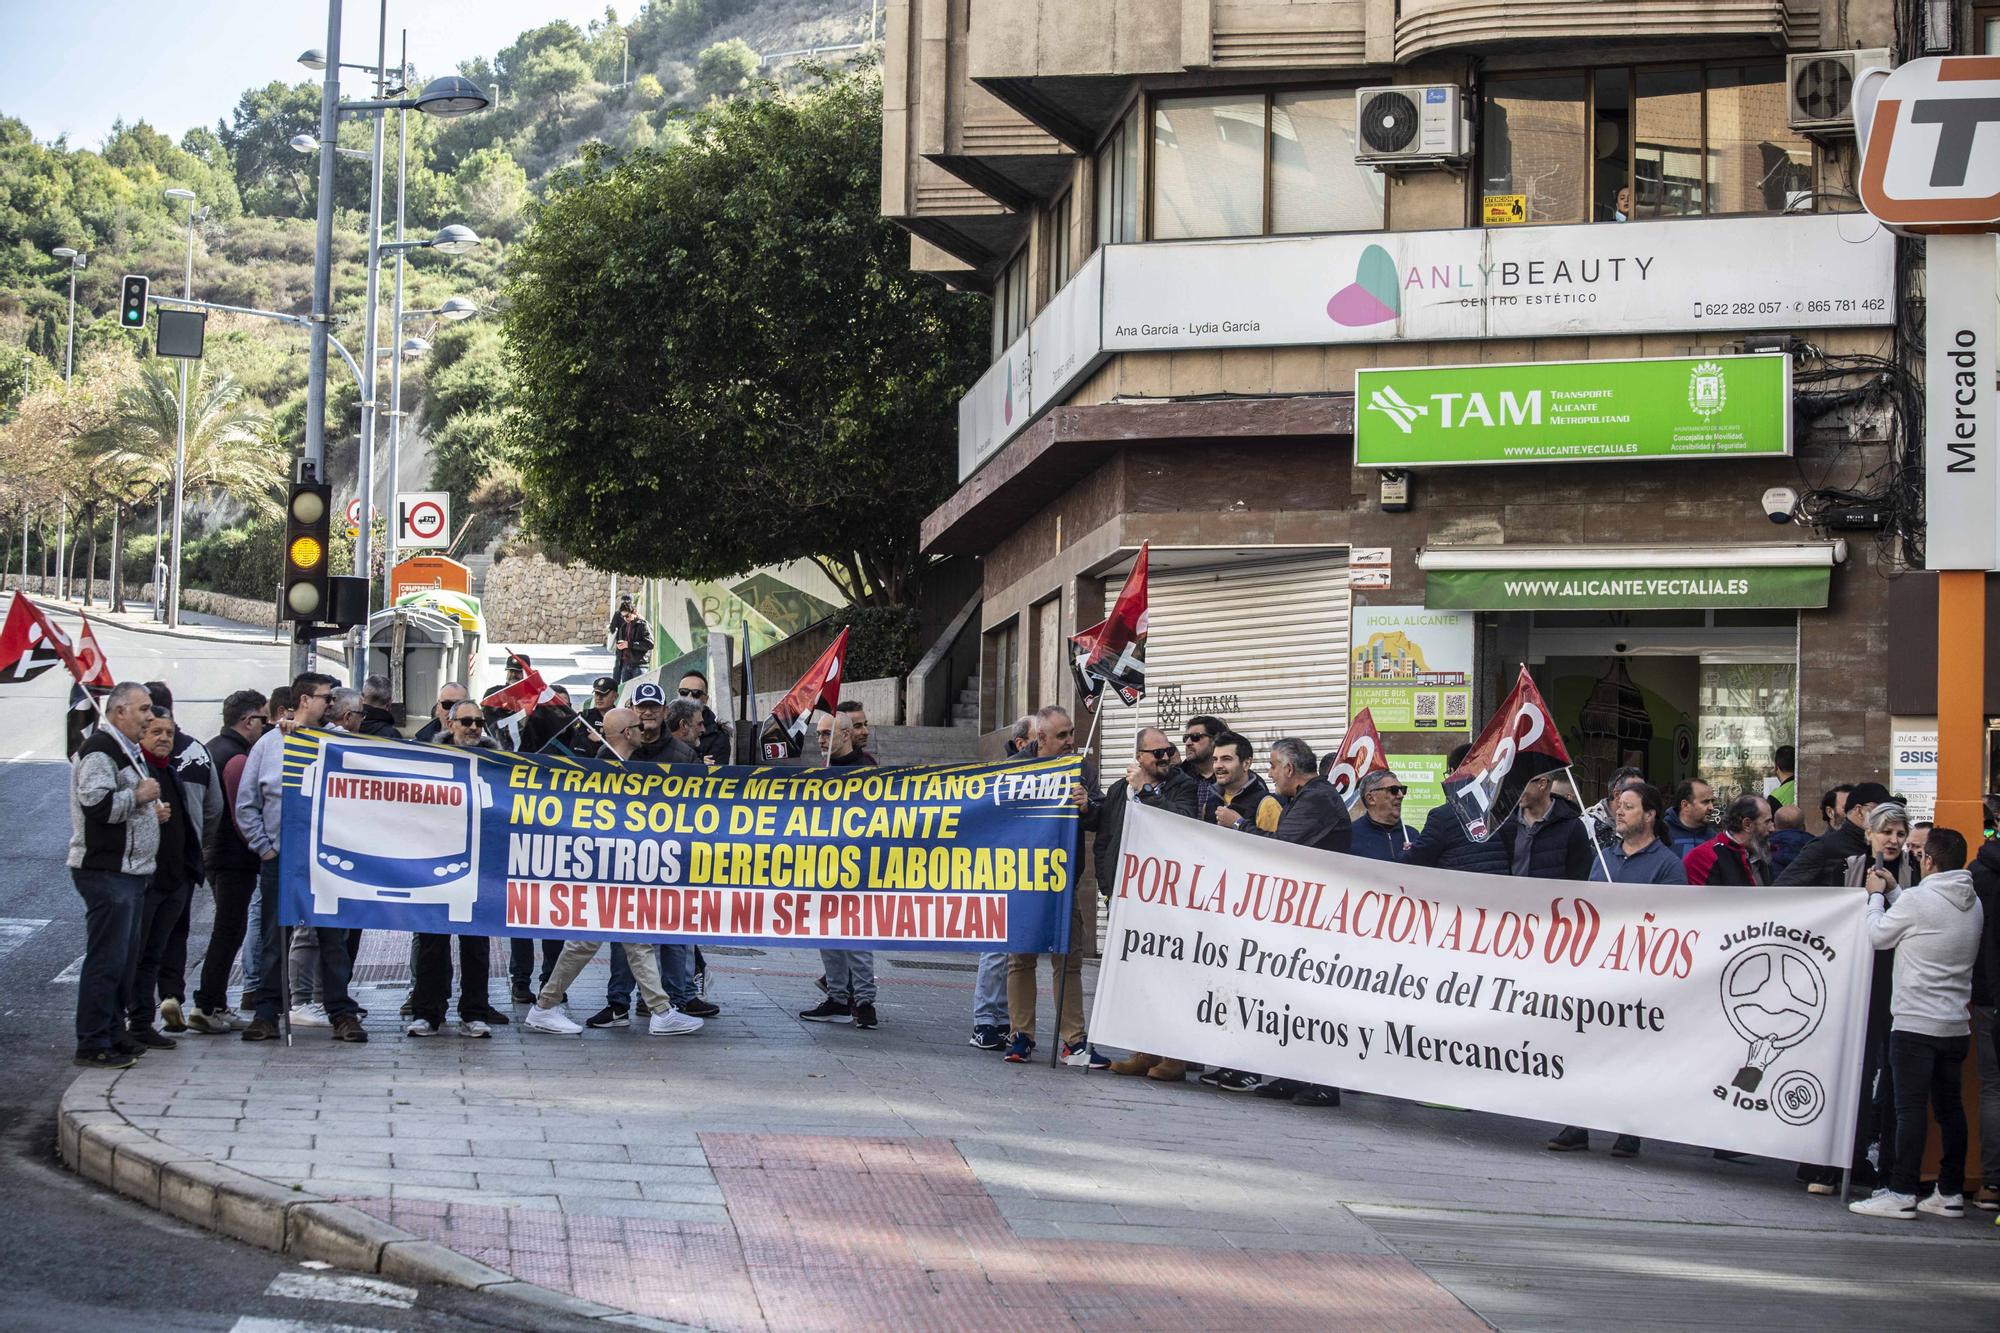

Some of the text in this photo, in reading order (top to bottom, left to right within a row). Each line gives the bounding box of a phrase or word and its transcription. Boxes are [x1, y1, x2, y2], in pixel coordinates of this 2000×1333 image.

[1461, 293, 1597, 308] CENTRO ESTÉTICO
[1705, 299, 1885, 316] 622 282 057 865 781 462
[1115, 320, 1260, 337] Ana García Lydia García
[1431, 390, 1542, 428] TAM
[1947, 330, 1976, 473] Mercado
[1504, 443, 1638, 456] WWW.ALICANTE.VECTALIA.ES
[1504, 579, 1749, 596] WWW.ALICANTE.VECTALIA.ES
[1404, 615, 1460, 626] ALICANTE!
[328, 777, 463, 807] INTERURBANO
[509, 765, 1071, 806] EL TRANSPORTE METROPOLITANO (TAM)
[510, 794, 961, 839] NO ES SOLO DE ALICANTE
[508, 833, 1067, 892] NUESTROS DERECHOS LABORABLES
[507, 882, 1006, 939] NI SE VENDEN NI SE PRIVATIZAN
[1118, 853, 1181, 906] POR
[1185, 864, 1227, 914] LA
[1438, 904, 1463, 951] A
[1466, 907, 1540, 960] LOS
[1544, 897, 1600, 968] 60
[1599, 912, 1701, 979] AÑOS
[1719, 920, 1838, 963] Jubilación
[1120, 928, 1665, 1033] para los Profesionales del Transporte
[1197, 991, 1564, 1081] de Viajeros y Mercancías
[1713, 1085, 1769, 1112] a los
